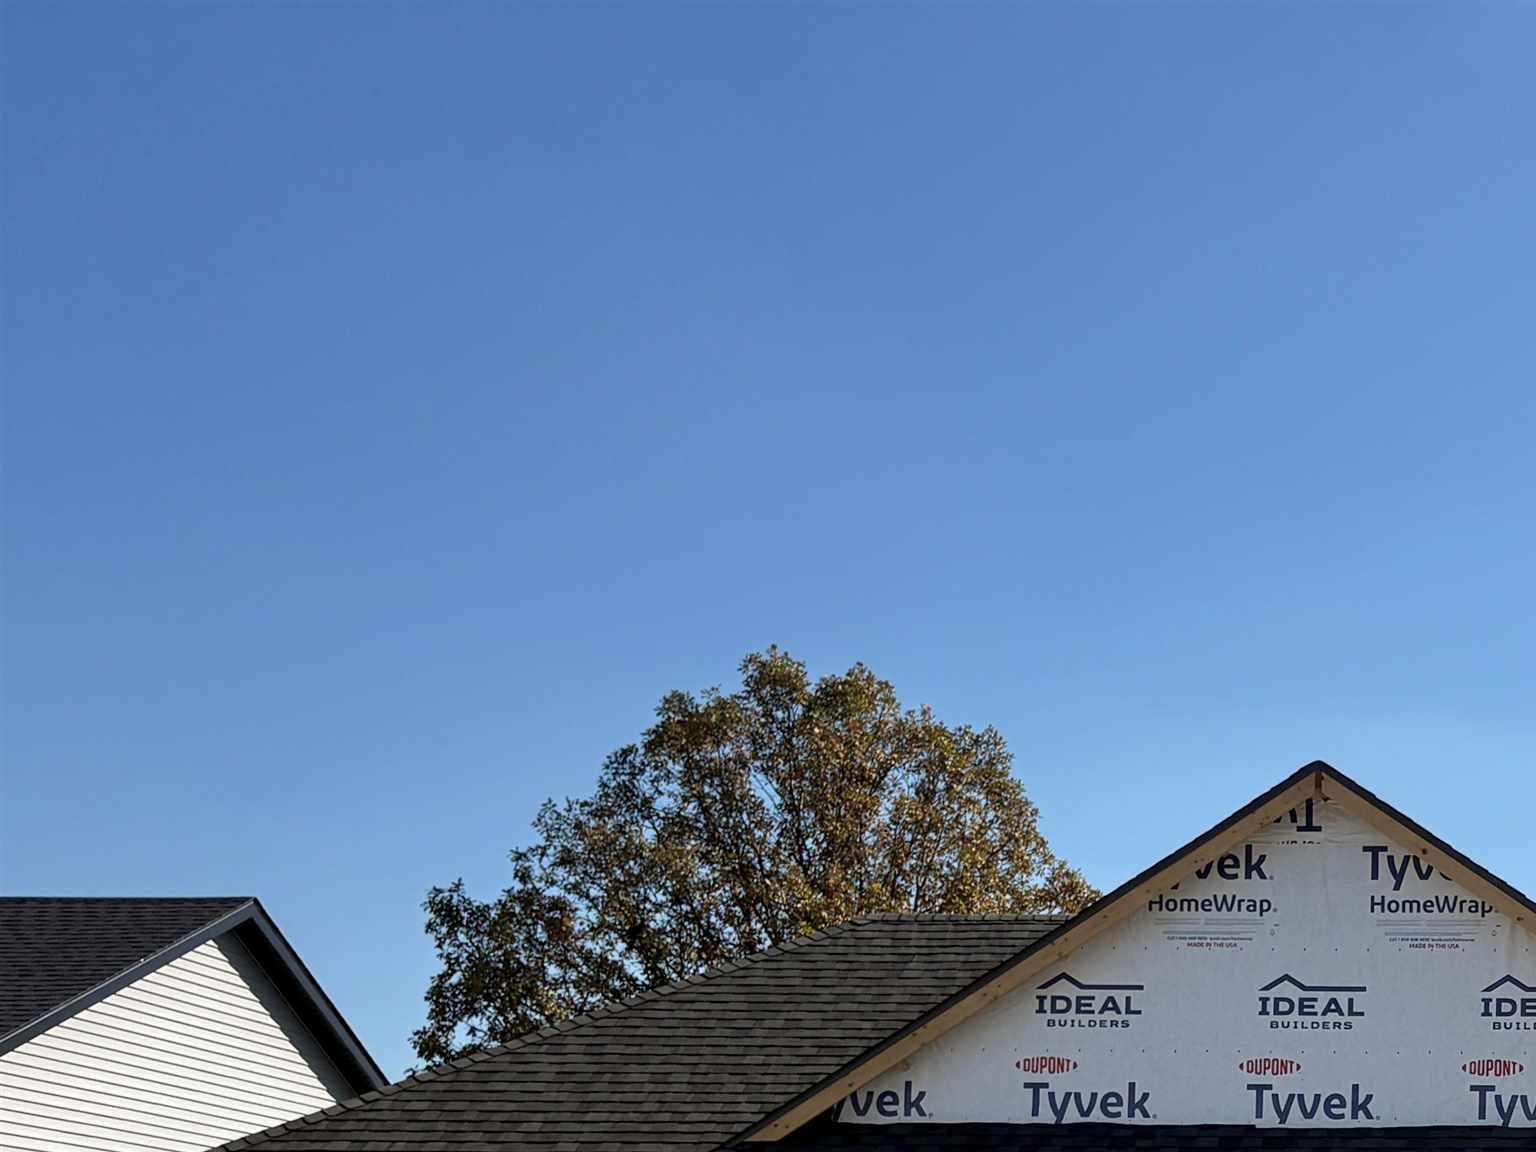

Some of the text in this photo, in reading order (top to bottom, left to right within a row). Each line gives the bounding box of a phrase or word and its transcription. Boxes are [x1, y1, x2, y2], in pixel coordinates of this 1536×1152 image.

[1362, 845, 1453, 891] Tyv
[1148, 894, 1272, 917] HomeWrap
[1370, 895, 1493, 918] HomeWrap
[1035, 995, 1142, 1015] IDEAL
[1258, 997, 1365, 1017] IDEAL
[1047, 1019, 1130, 1028] BUILDERS
[1270, 1021, 1353, 1030] BUILDERS
[1023, 1056, 1071, 1074] DUPONT
[1246, 1058, 1295, 1076] DUPONT
[1469, 1059, 1518, 1077] DUPONT
[832, 1080, 927, 1121] vek
[1023, 1082, 1151, 1124] Tyvek
[1246, 1083, 1375, 1125] Tyvek
